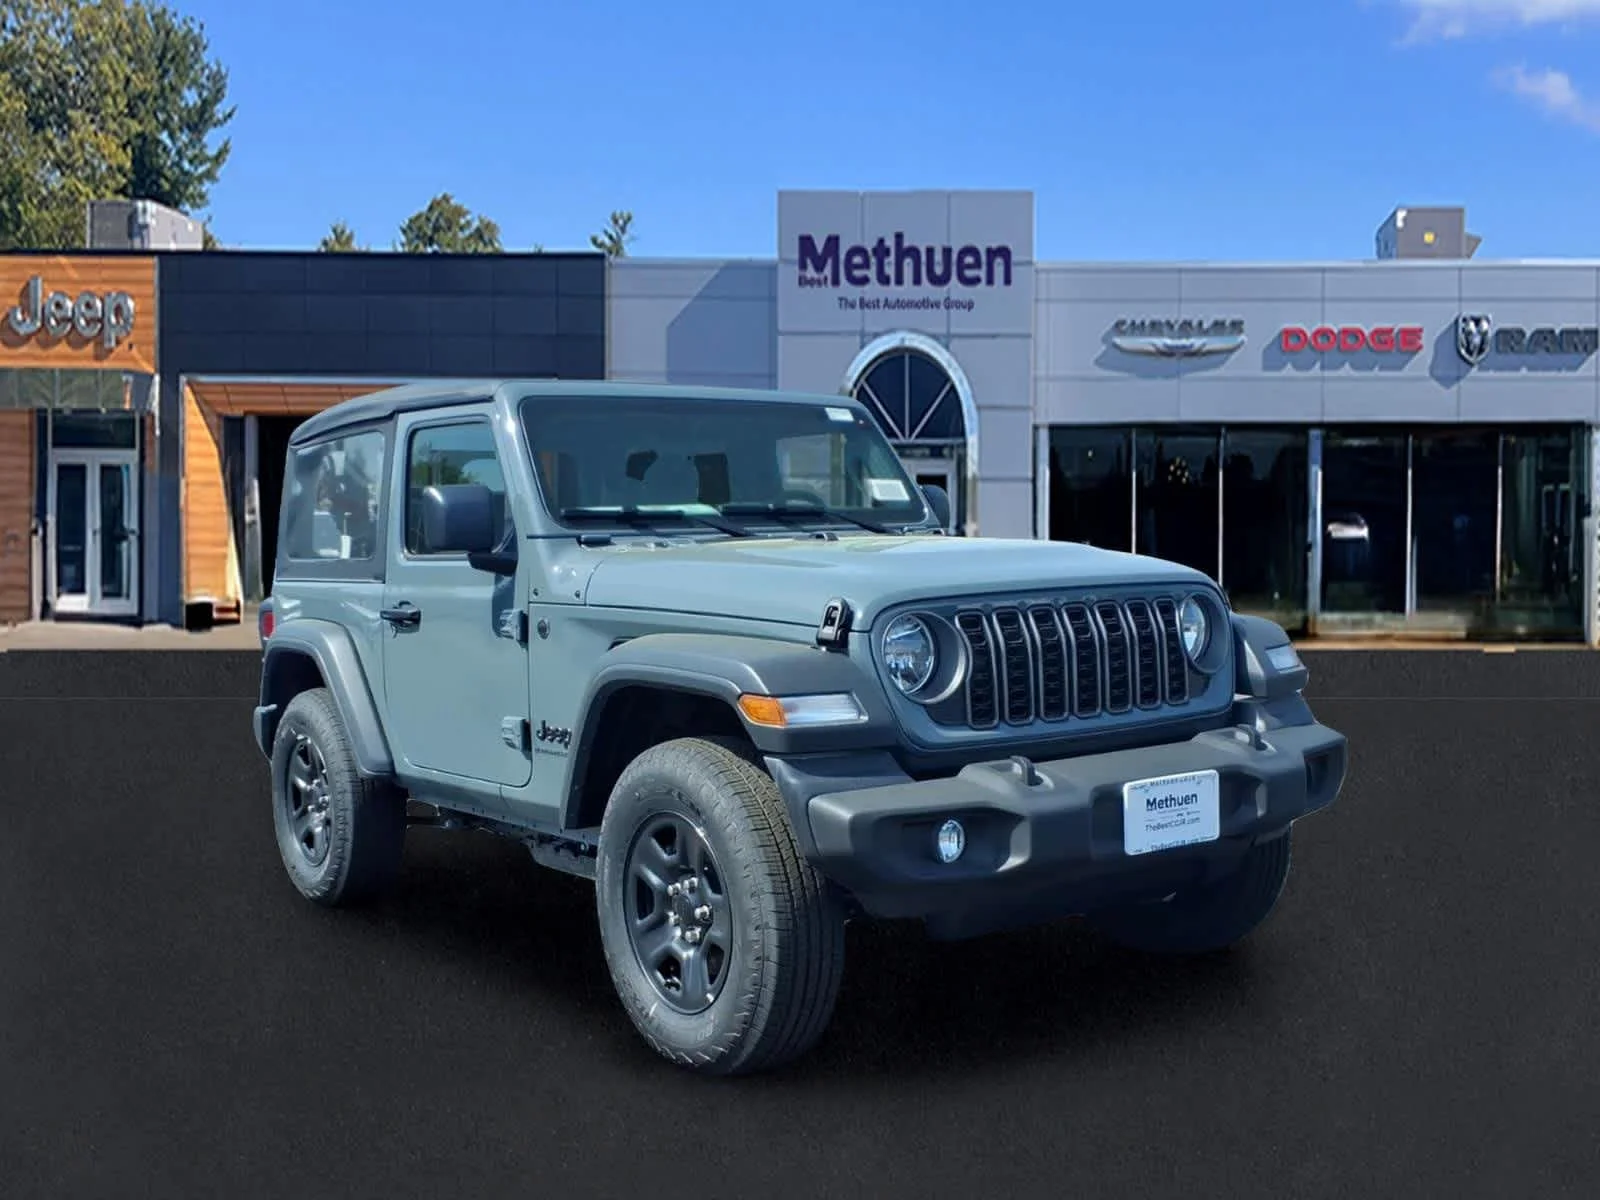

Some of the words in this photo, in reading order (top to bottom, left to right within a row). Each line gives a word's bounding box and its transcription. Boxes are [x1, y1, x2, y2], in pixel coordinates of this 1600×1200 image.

[798, 231, 1012, 287] Methuen
[8, 275, 135, 348] Jeep
[838, 297, 857, 310] The
[859, 297, 880, 310] Best
[883, 297, 941, 310] Automotive
[943, 297, 975, 312] Group
[1281, 326, 1424, 352] DODGE
[1495, 328, 1598, 353] RAM
[536, 719, 572, 749] Jeep
[1145, 793, 1198, 812] Methuen
